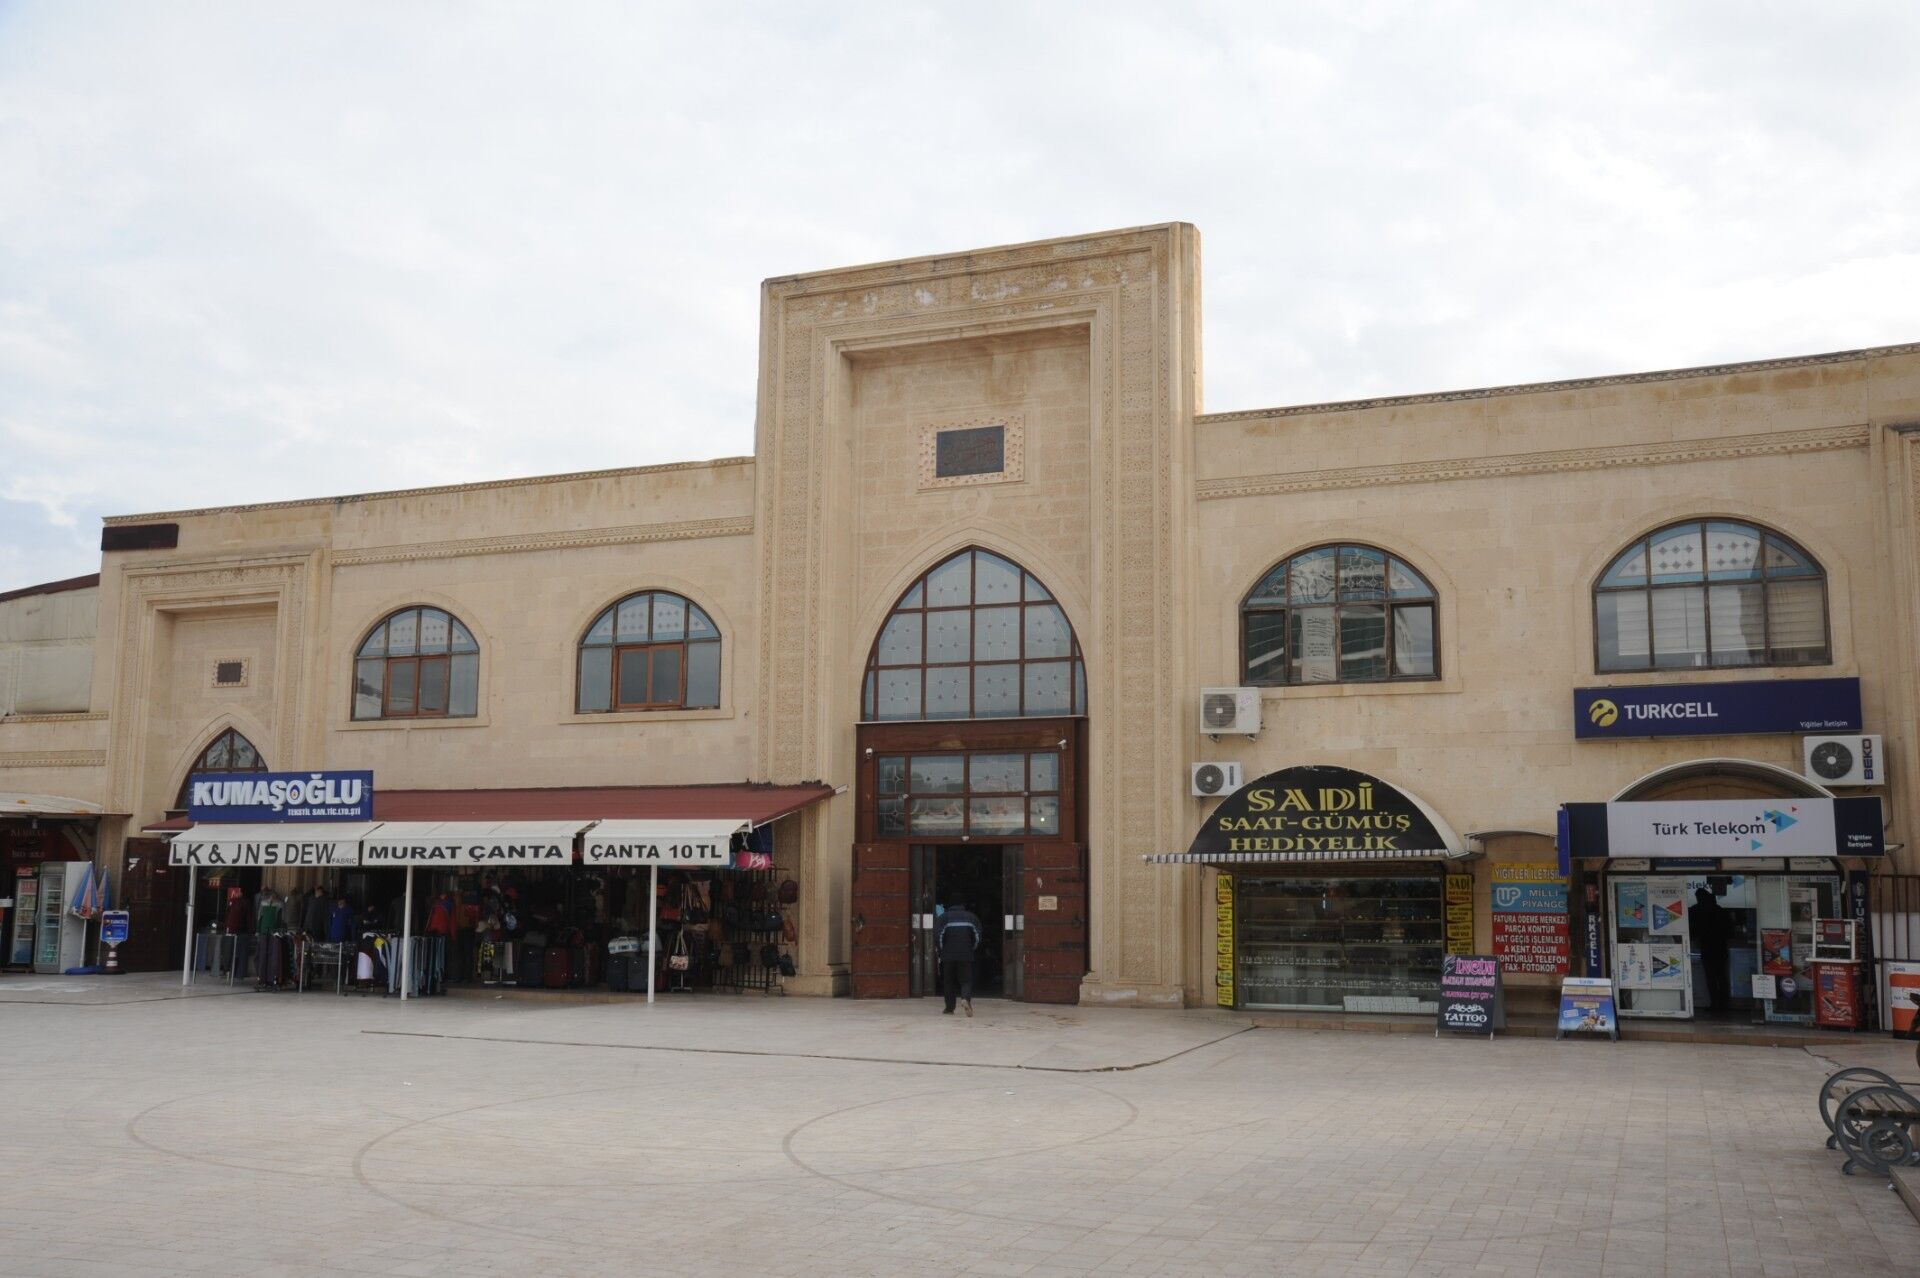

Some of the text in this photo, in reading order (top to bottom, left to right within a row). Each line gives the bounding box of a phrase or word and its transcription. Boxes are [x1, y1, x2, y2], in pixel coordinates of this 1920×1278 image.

[1624, 702, 1718, 720] TURKCELL
[1862, 739, 1873, 780] BEKO
[193, 773, 362, 812] KUMAŞOĞLU
[1247, 782, 1374, 812] SADİ
[1219, 811, 1411, 833] SAAT-GÜMÜŞ
[1652, 821, 1766, 836] Türk Telekom
[1229, 833, 1399, 851] HEDİYELİK
[208, 843, 227, 865] &
[285, 843, 336, 864] DEW
[368, 845, 563, 862] MURAT ÇANTA
[590, 844, 660, 861] ÇANTA
[1535, 955, 1567, 964] TELEFON
[1444, 1012, 1488, 1023] TATTOO
